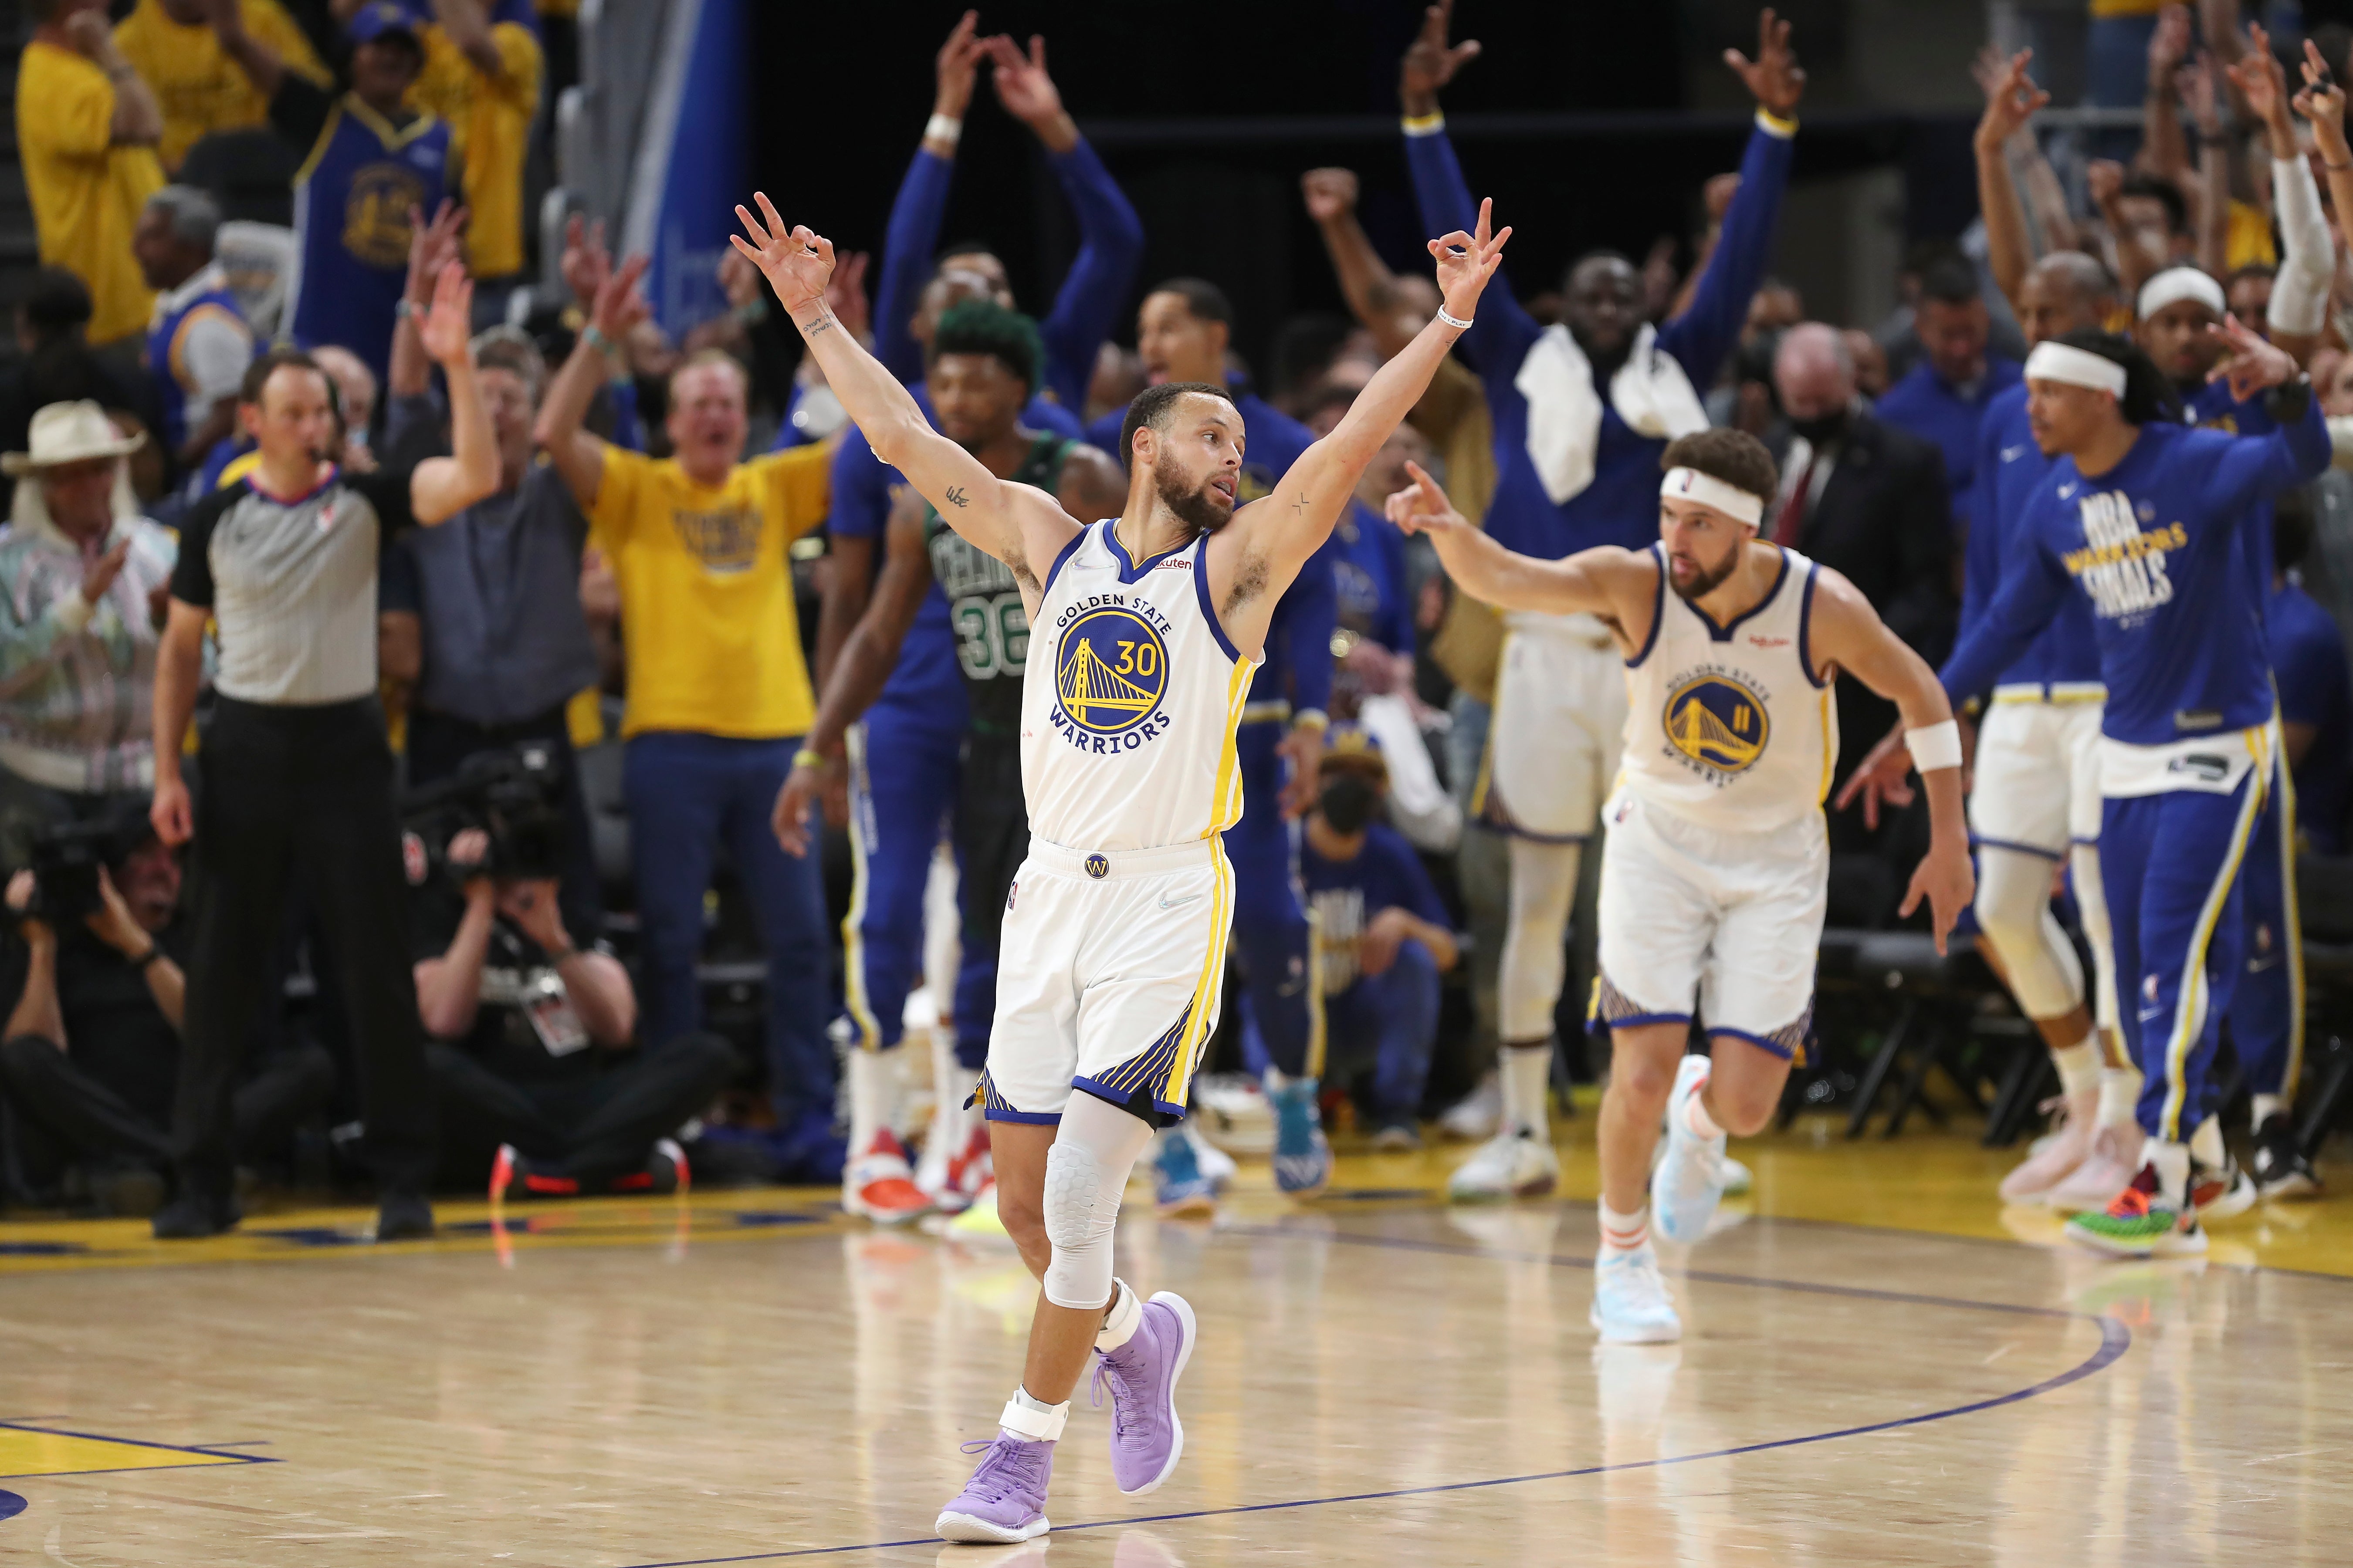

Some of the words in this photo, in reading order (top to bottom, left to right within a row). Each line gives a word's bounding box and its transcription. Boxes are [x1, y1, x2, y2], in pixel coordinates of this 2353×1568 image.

[1154, 558, 1192, 570] kuten
[1057, 594, 1124, 627] GOLDEN
[1132, 598, 1171, 635] STATE
[1114, 640, 1157, 676] 30
[1050, 703, 1170, 754] WARRIORS
[1733, 704, 1750, 733] 11
[1086, 860, 1107, 875] W
[1010, 1442, 1022, 1461] CURY
